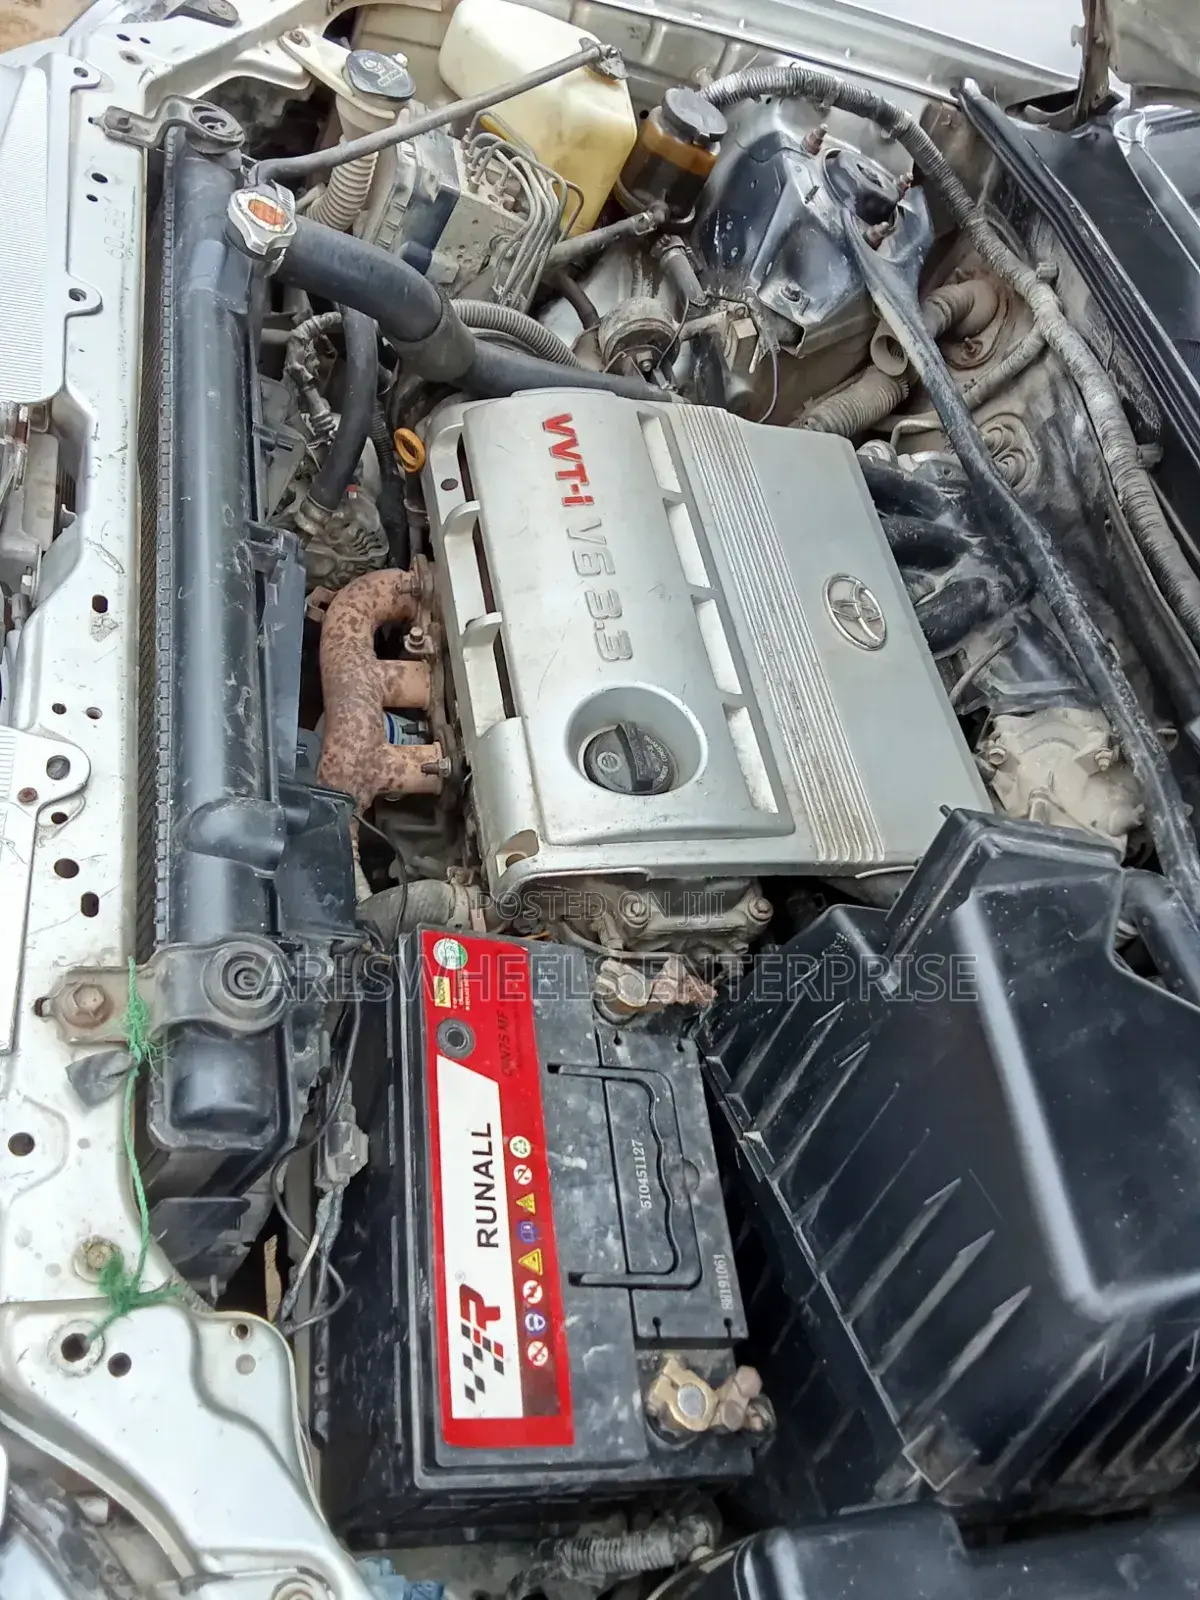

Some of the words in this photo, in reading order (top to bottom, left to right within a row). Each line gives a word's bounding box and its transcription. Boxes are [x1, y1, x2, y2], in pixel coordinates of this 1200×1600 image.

[542, 412, 595, 507] VVT-i
[566, 517, 616, 577] V6
[584, 588, 634, 662] 3.3
[470, 1122, 499, 1248] RUNALL
